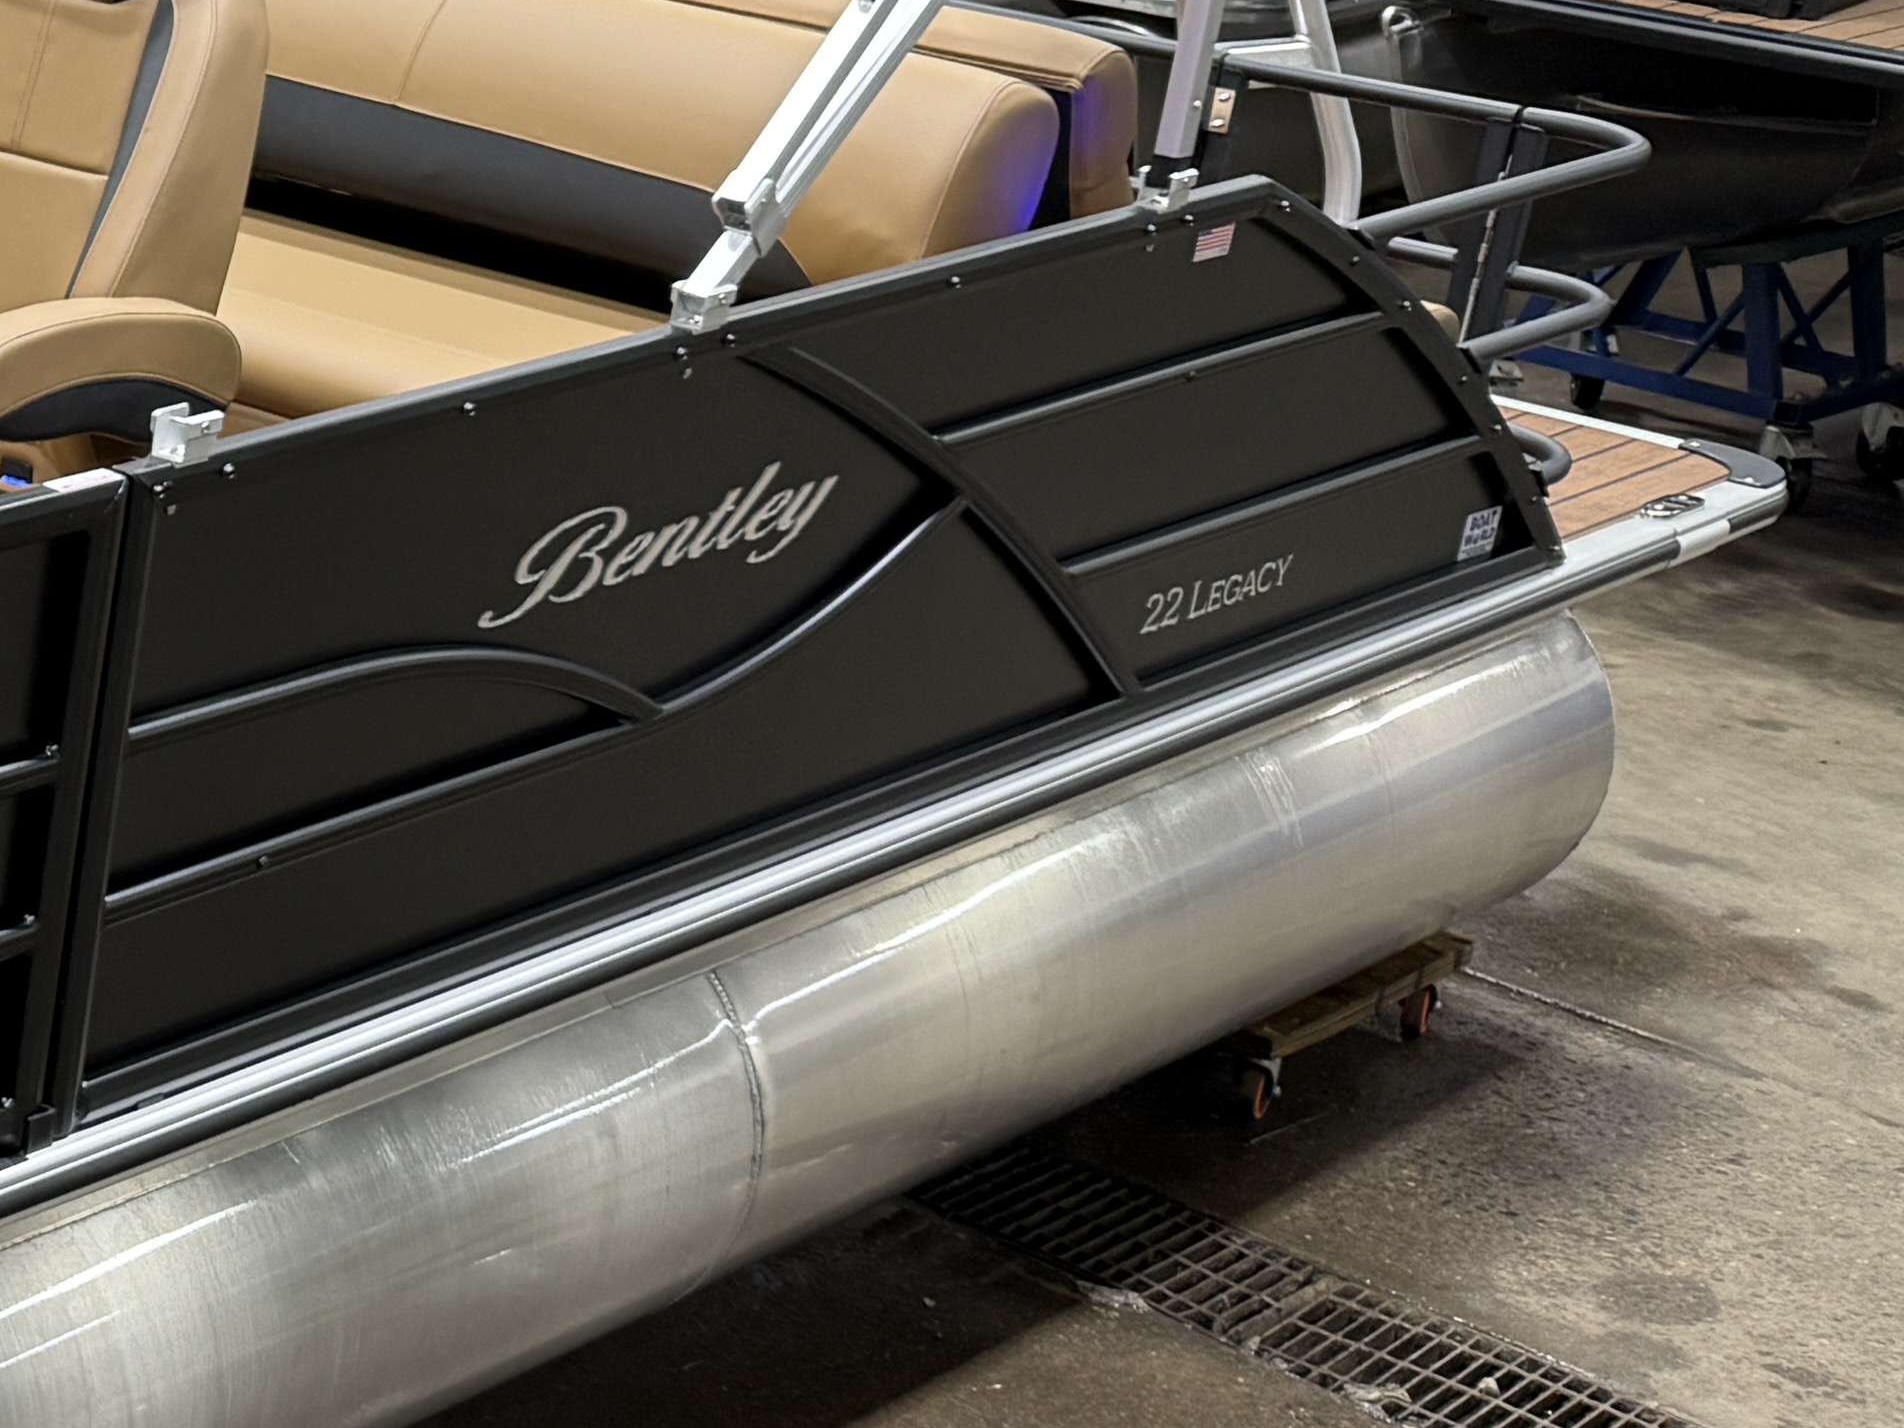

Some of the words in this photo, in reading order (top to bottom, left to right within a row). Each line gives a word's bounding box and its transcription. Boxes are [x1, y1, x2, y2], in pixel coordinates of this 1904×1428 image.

[476, 460, 840, 629] Bentley
[1139, 586, 1185, 635] 22
[1187, 553, 1295, 620] LEGACY
